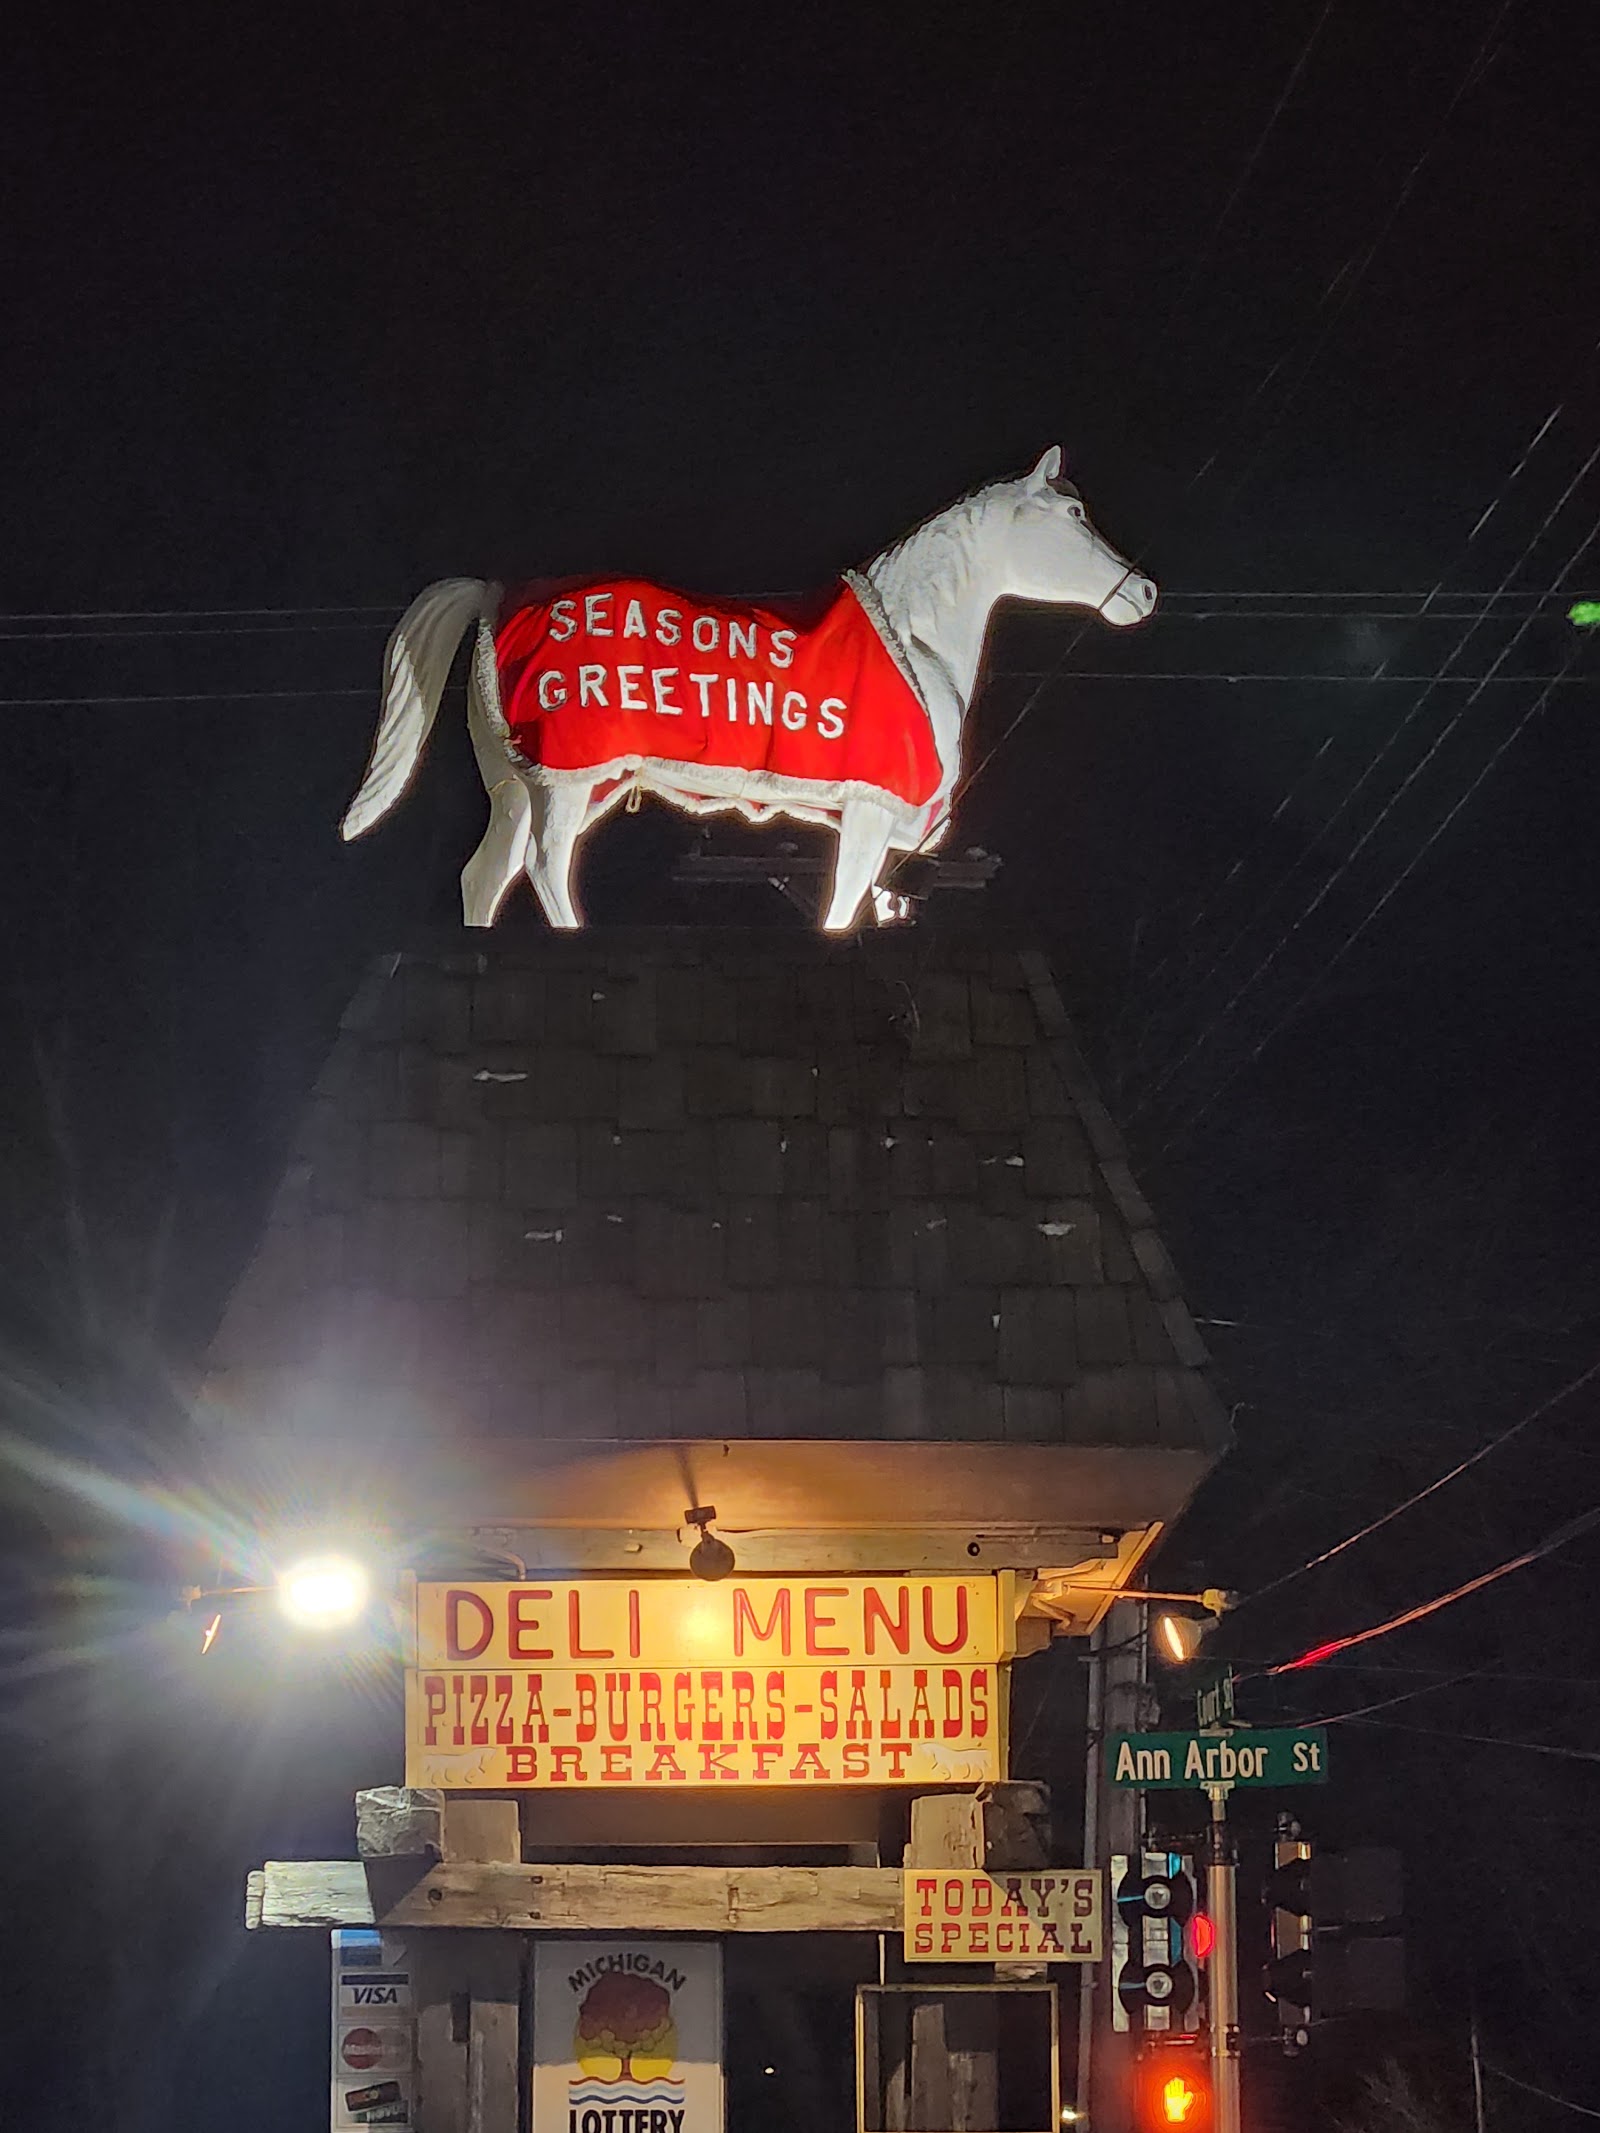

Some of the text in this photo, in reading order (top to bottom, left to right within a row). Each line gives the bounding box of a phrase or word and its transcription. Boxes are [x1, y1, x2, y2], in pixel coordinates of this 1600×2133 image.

[549, 593, 797, 668] SEASONS
[538, 665, 847, 739] GREETINGS
[446, 1585, 969, 1661] DELI MENU
[424, 1668, 989, 1746] PIZZA-BURGERS-SALADS
[506, 1743, 913, 1782] BREAKFAST
[1115, 1740, 1321, 1781] Ann Arbor St
[916, 1878, 1093, 1917] TODAY'S
[915, 1923, 1092, 1954] SPECIAL
[568, 1952, 687, 1993] MICHIGAN
[353, 1987, 398, 2004] VISA
